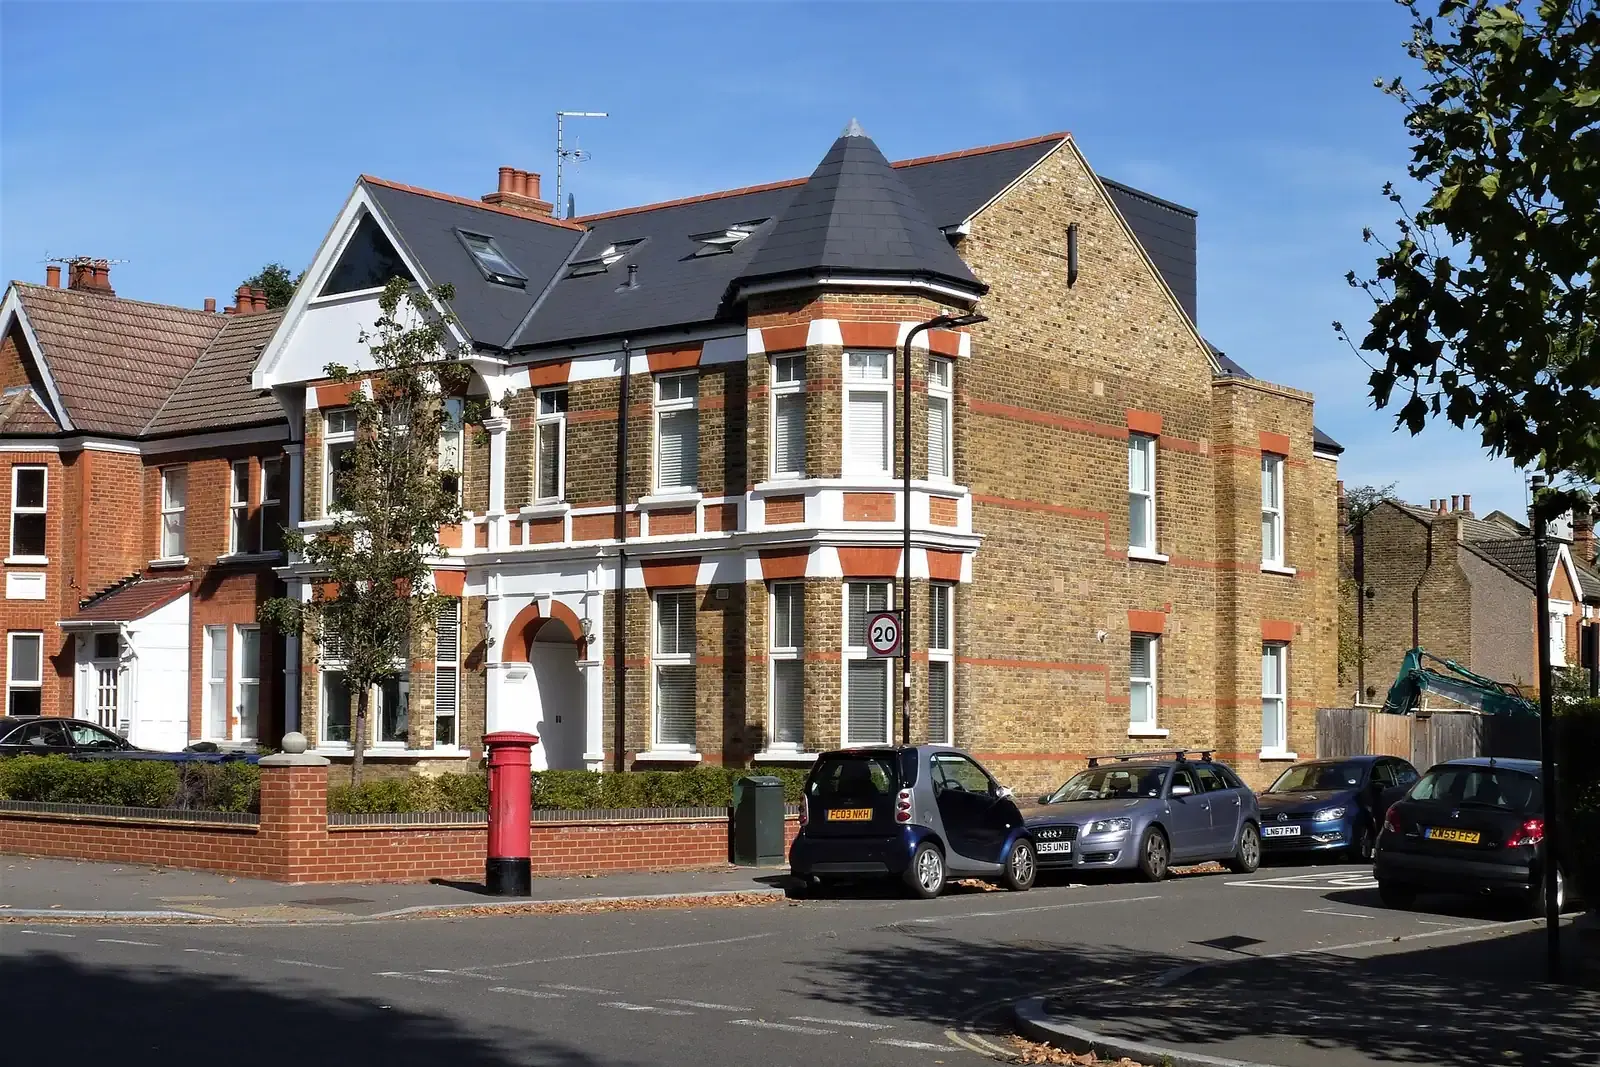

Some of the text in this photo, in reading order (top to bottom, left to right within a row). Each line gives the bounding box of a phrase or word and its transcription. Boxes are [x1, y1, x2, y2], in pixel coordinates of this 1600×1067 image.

[873, 626, 896, 643] 20
[830, 809, 870, 819] FC03 NKH
[1266, 827, 1284, 836] LN67
[1053, 842, 1069, 851] UNB
